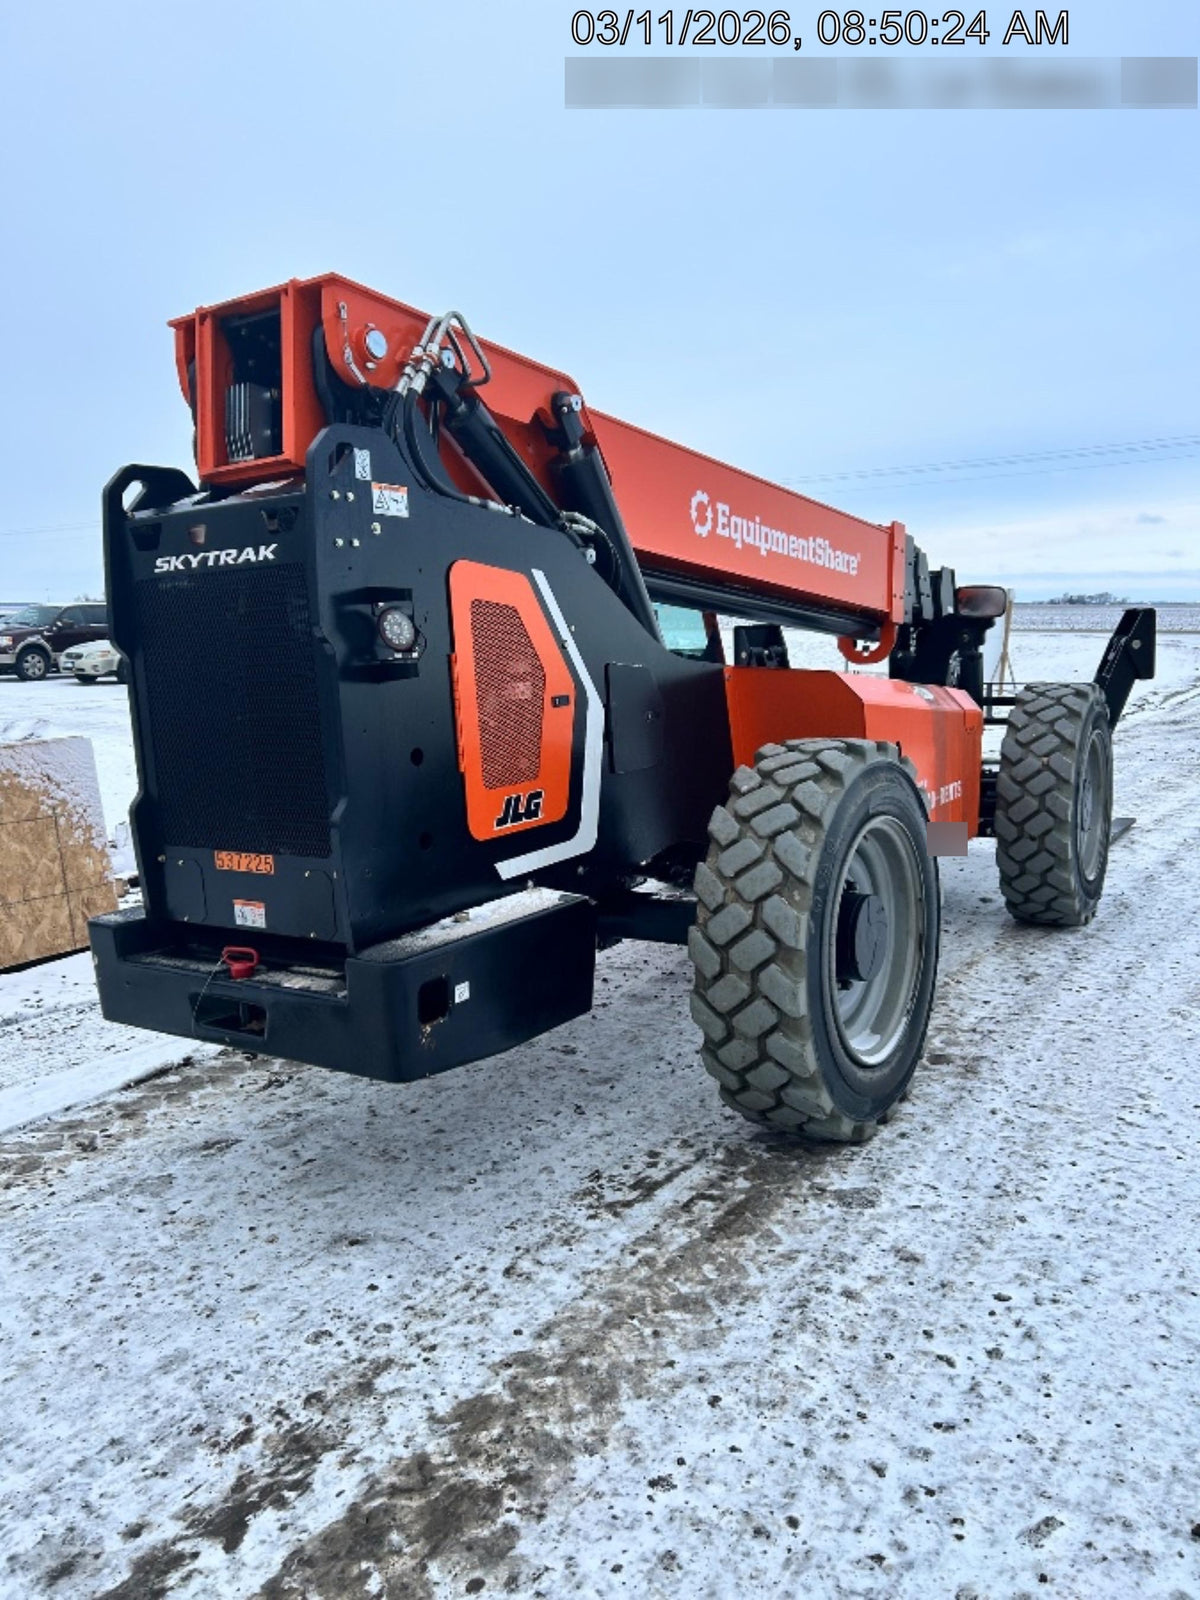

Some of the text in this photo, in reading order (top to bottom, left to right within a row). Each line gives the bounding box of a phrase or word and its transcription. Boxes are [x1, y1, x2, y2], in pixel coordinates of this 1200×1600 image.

[716, 502, 858, 576] EquipmentShare
[154, 543, 278, 573] SKYTRAK
[494, 789, 545, 830] JLG
[216, 852, 273, 873] 537225
